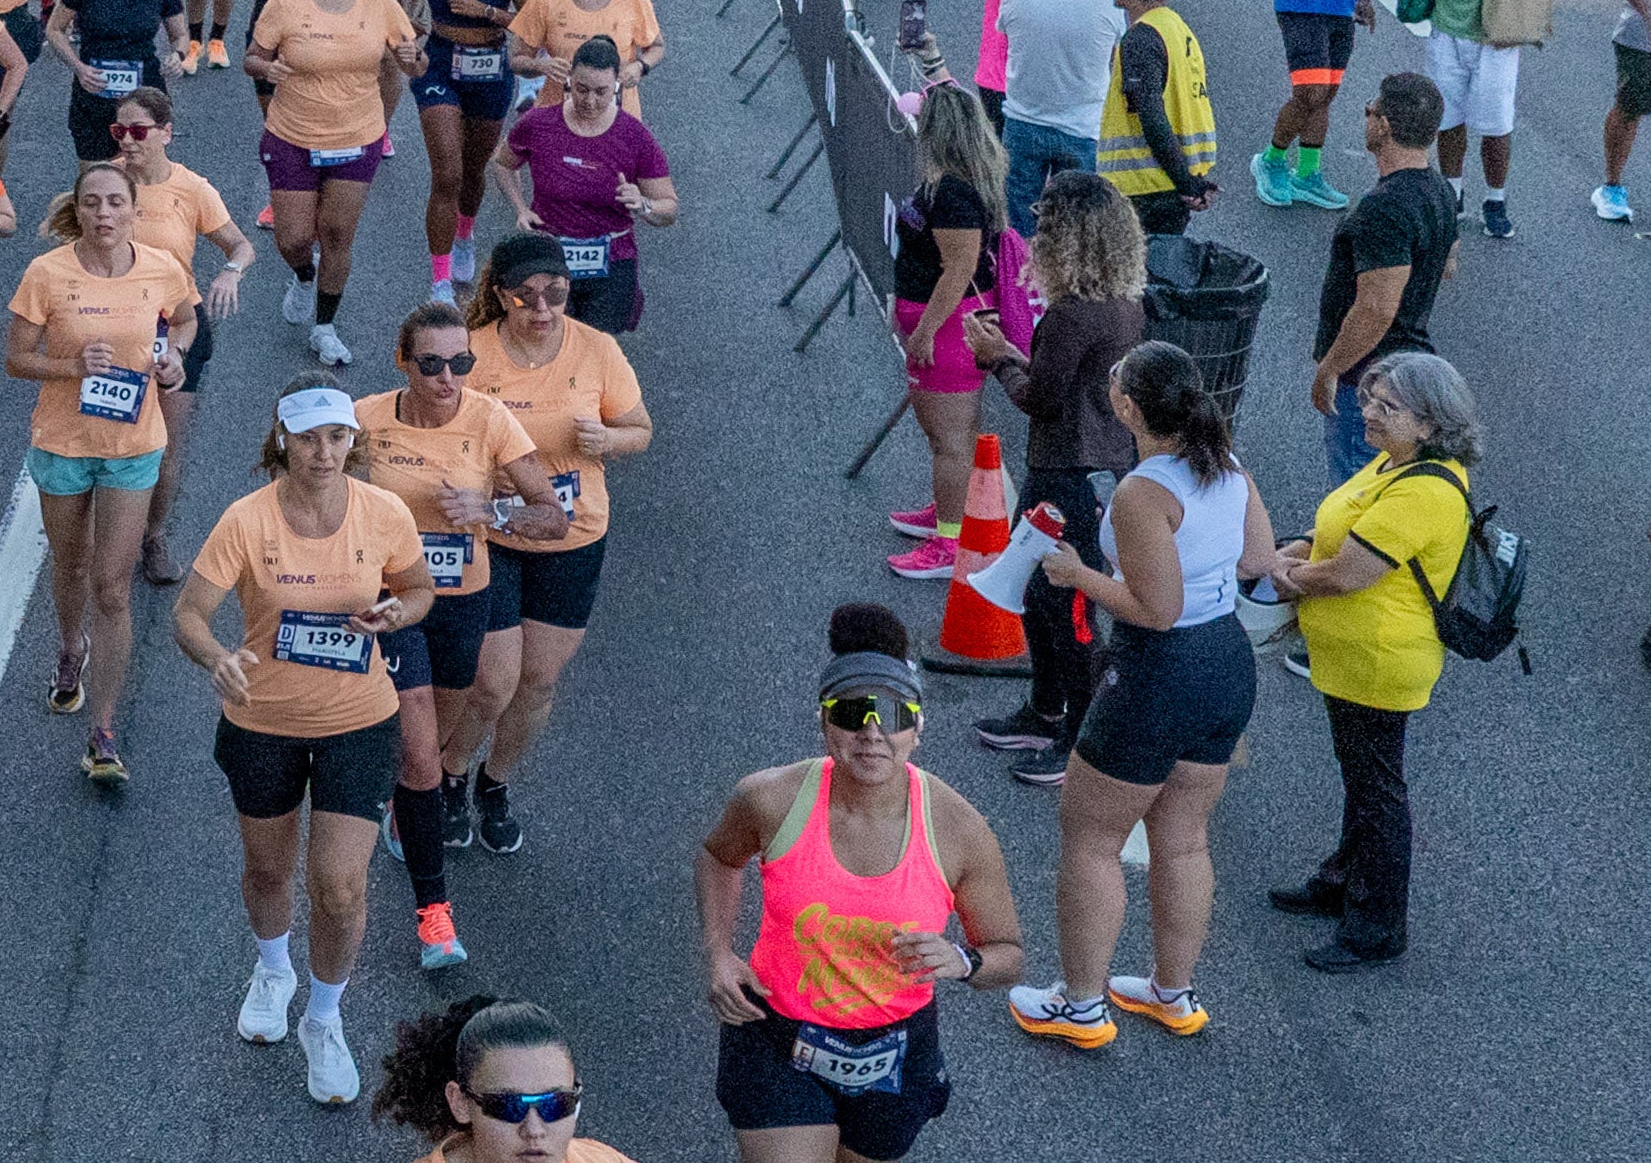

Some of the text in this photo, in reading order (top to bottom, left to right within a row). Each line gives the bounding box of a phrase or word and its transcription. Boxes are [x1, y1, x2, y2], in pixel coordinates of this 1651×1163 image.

[470, 57, 494, 69] 730
[105, 73, 133, 84] 1974
[565, 250, 599, 262] 2142
[89, 379, 132, 402] 2140
[281, 626, 357, 649] D 1399
[828, 1057, 888, 1076] 1965
